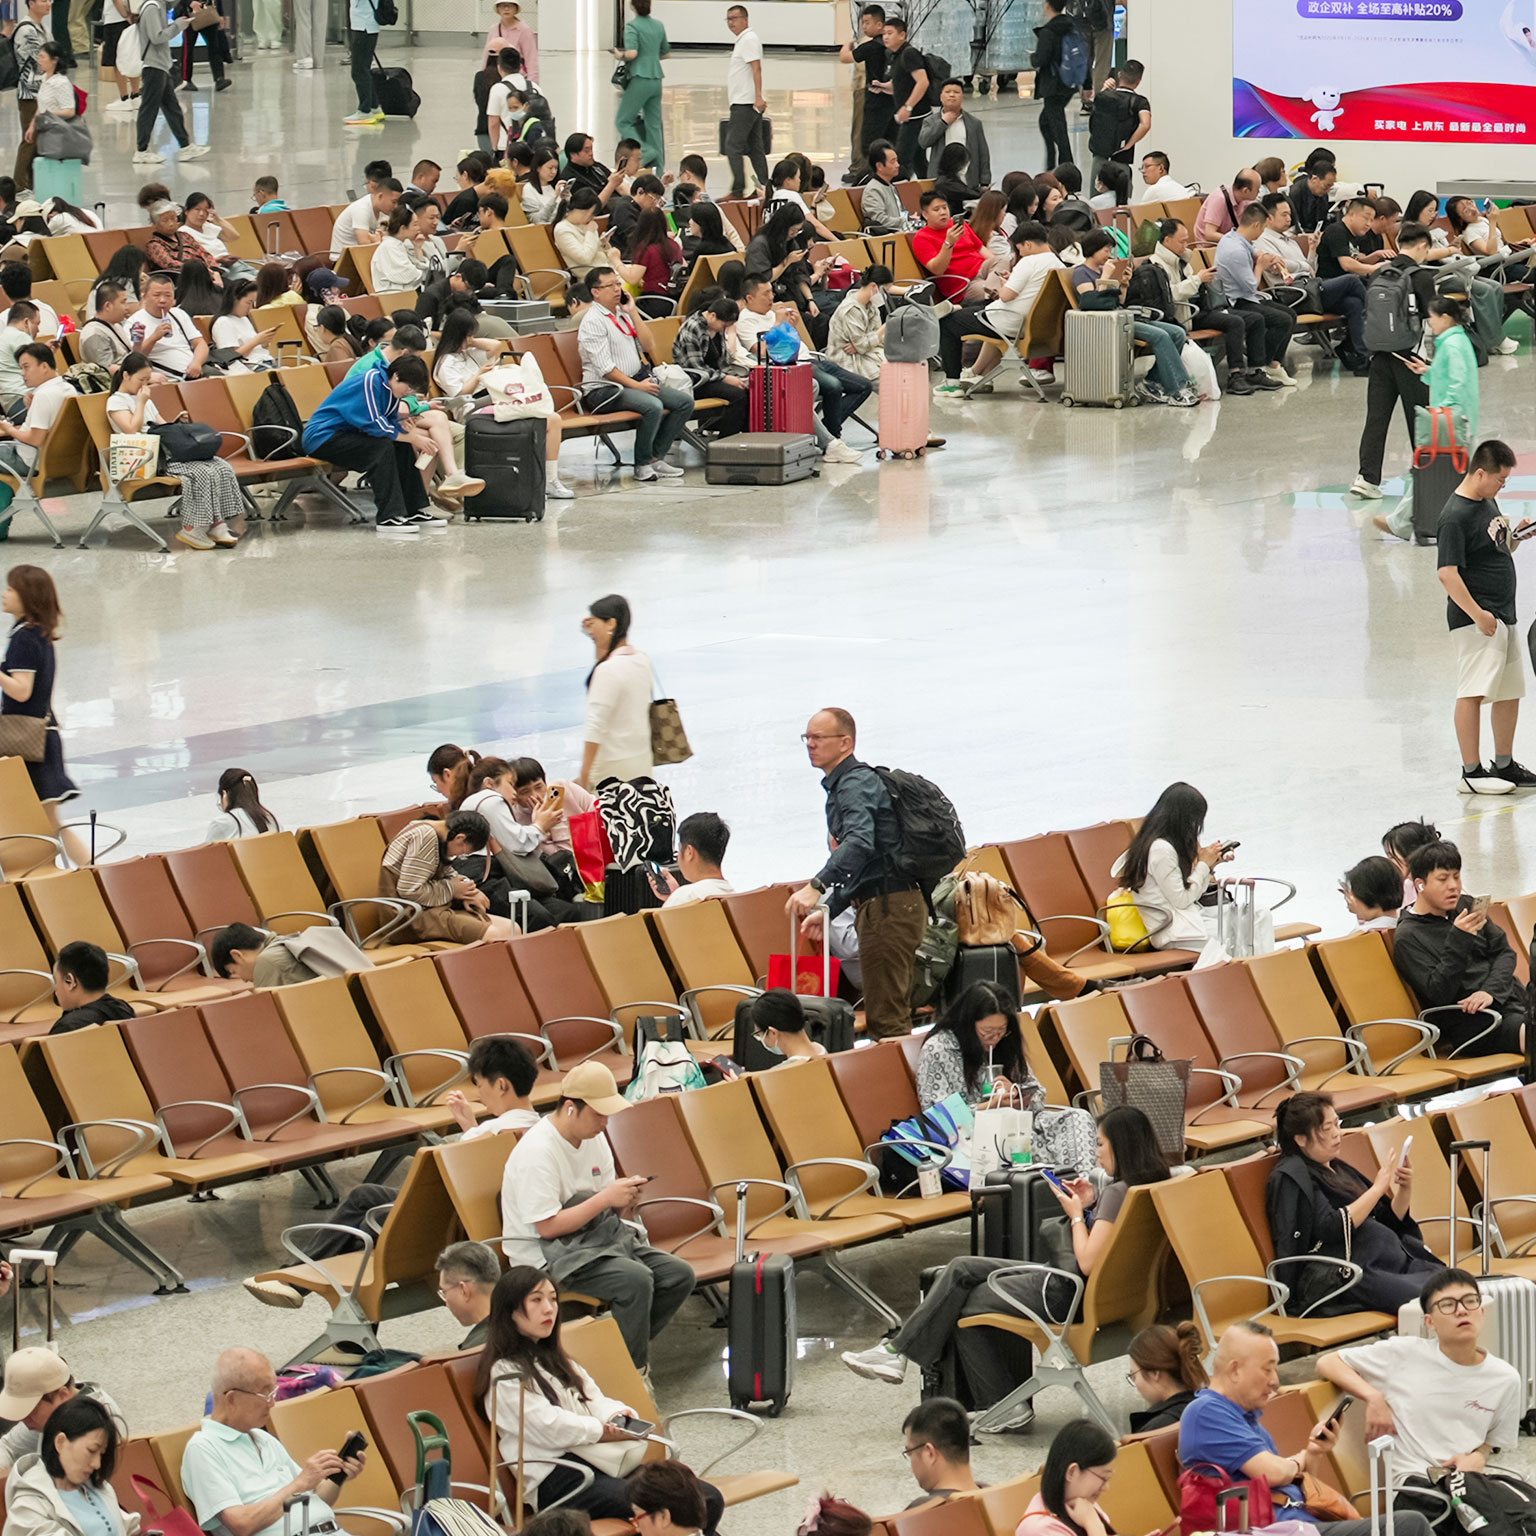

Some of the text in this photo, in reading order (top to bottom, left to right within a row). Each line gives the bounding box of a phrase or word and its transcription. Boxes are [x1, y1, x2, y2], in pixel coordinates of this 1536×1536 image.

[1307, 1, 1453, 18] 政企双补 全场至高补贴20%
[1374, 119, 1527, 134] 买家电 上京东 最新最全最时尚
